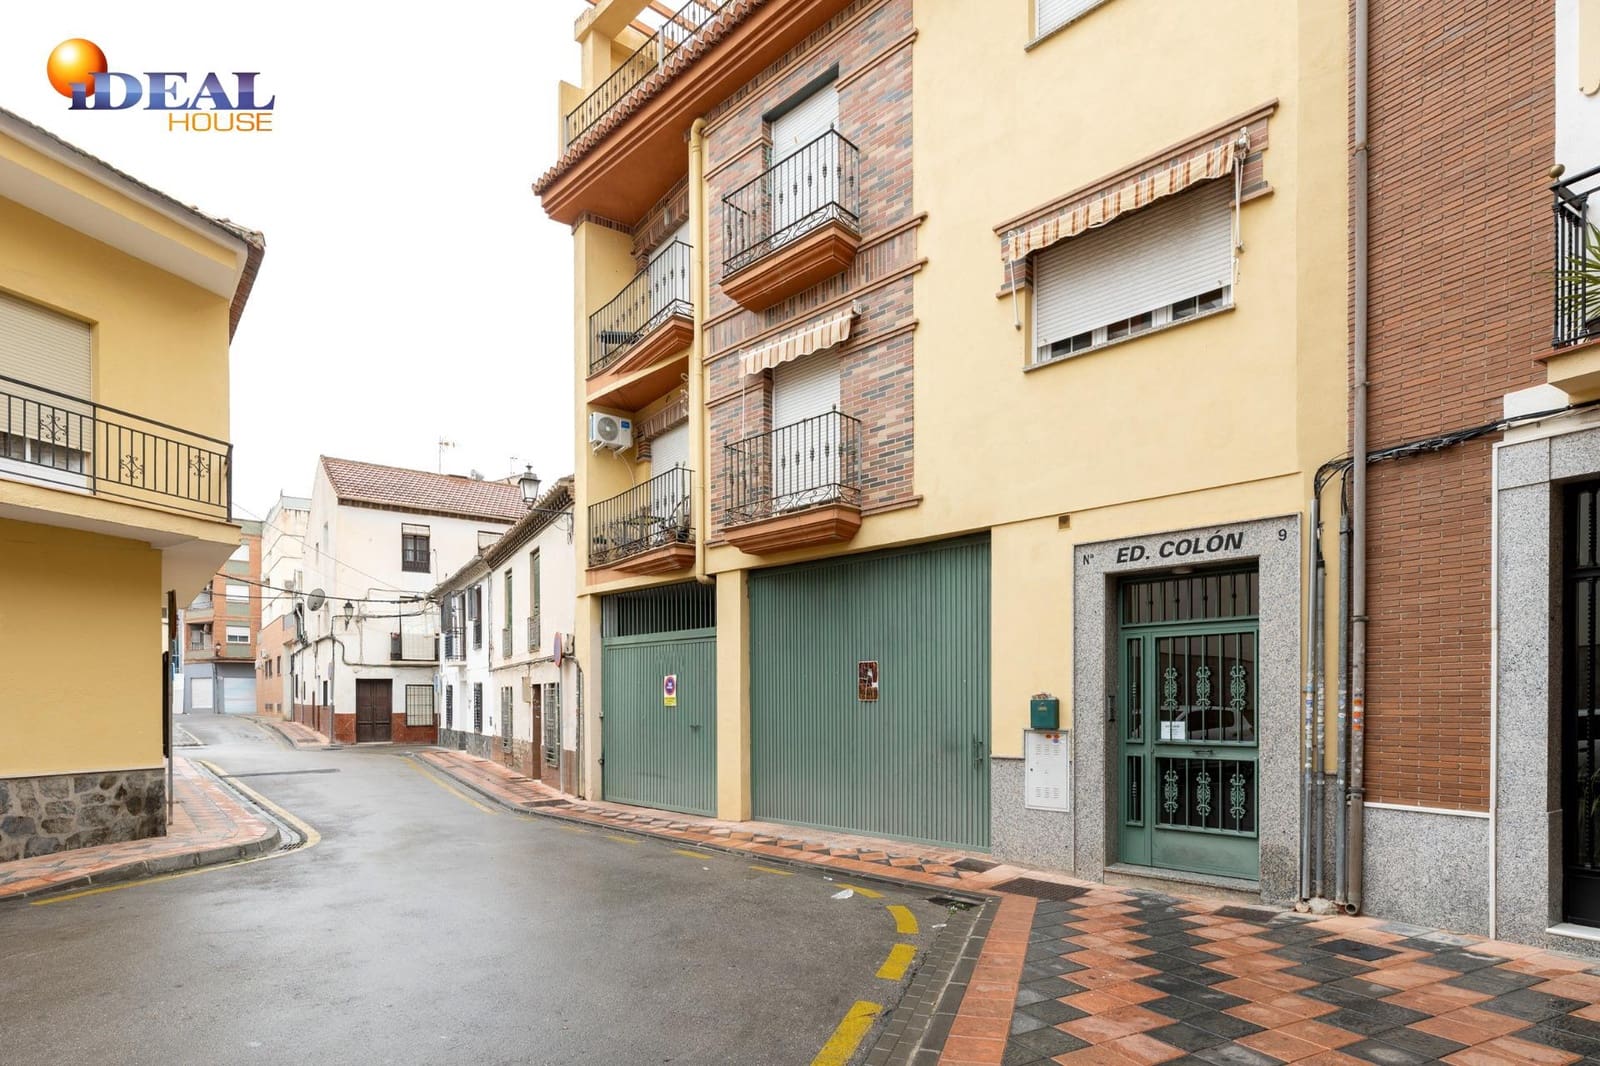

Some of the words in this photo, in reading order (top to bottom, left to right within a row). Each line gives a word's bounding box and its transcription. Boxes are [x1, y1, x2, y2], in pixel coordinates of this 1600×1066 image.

[1116, 544, 1150, 564] ED.
[1159, 530, 1244, 558] COLÓN
[1278, 528, 1288, 542] 9
